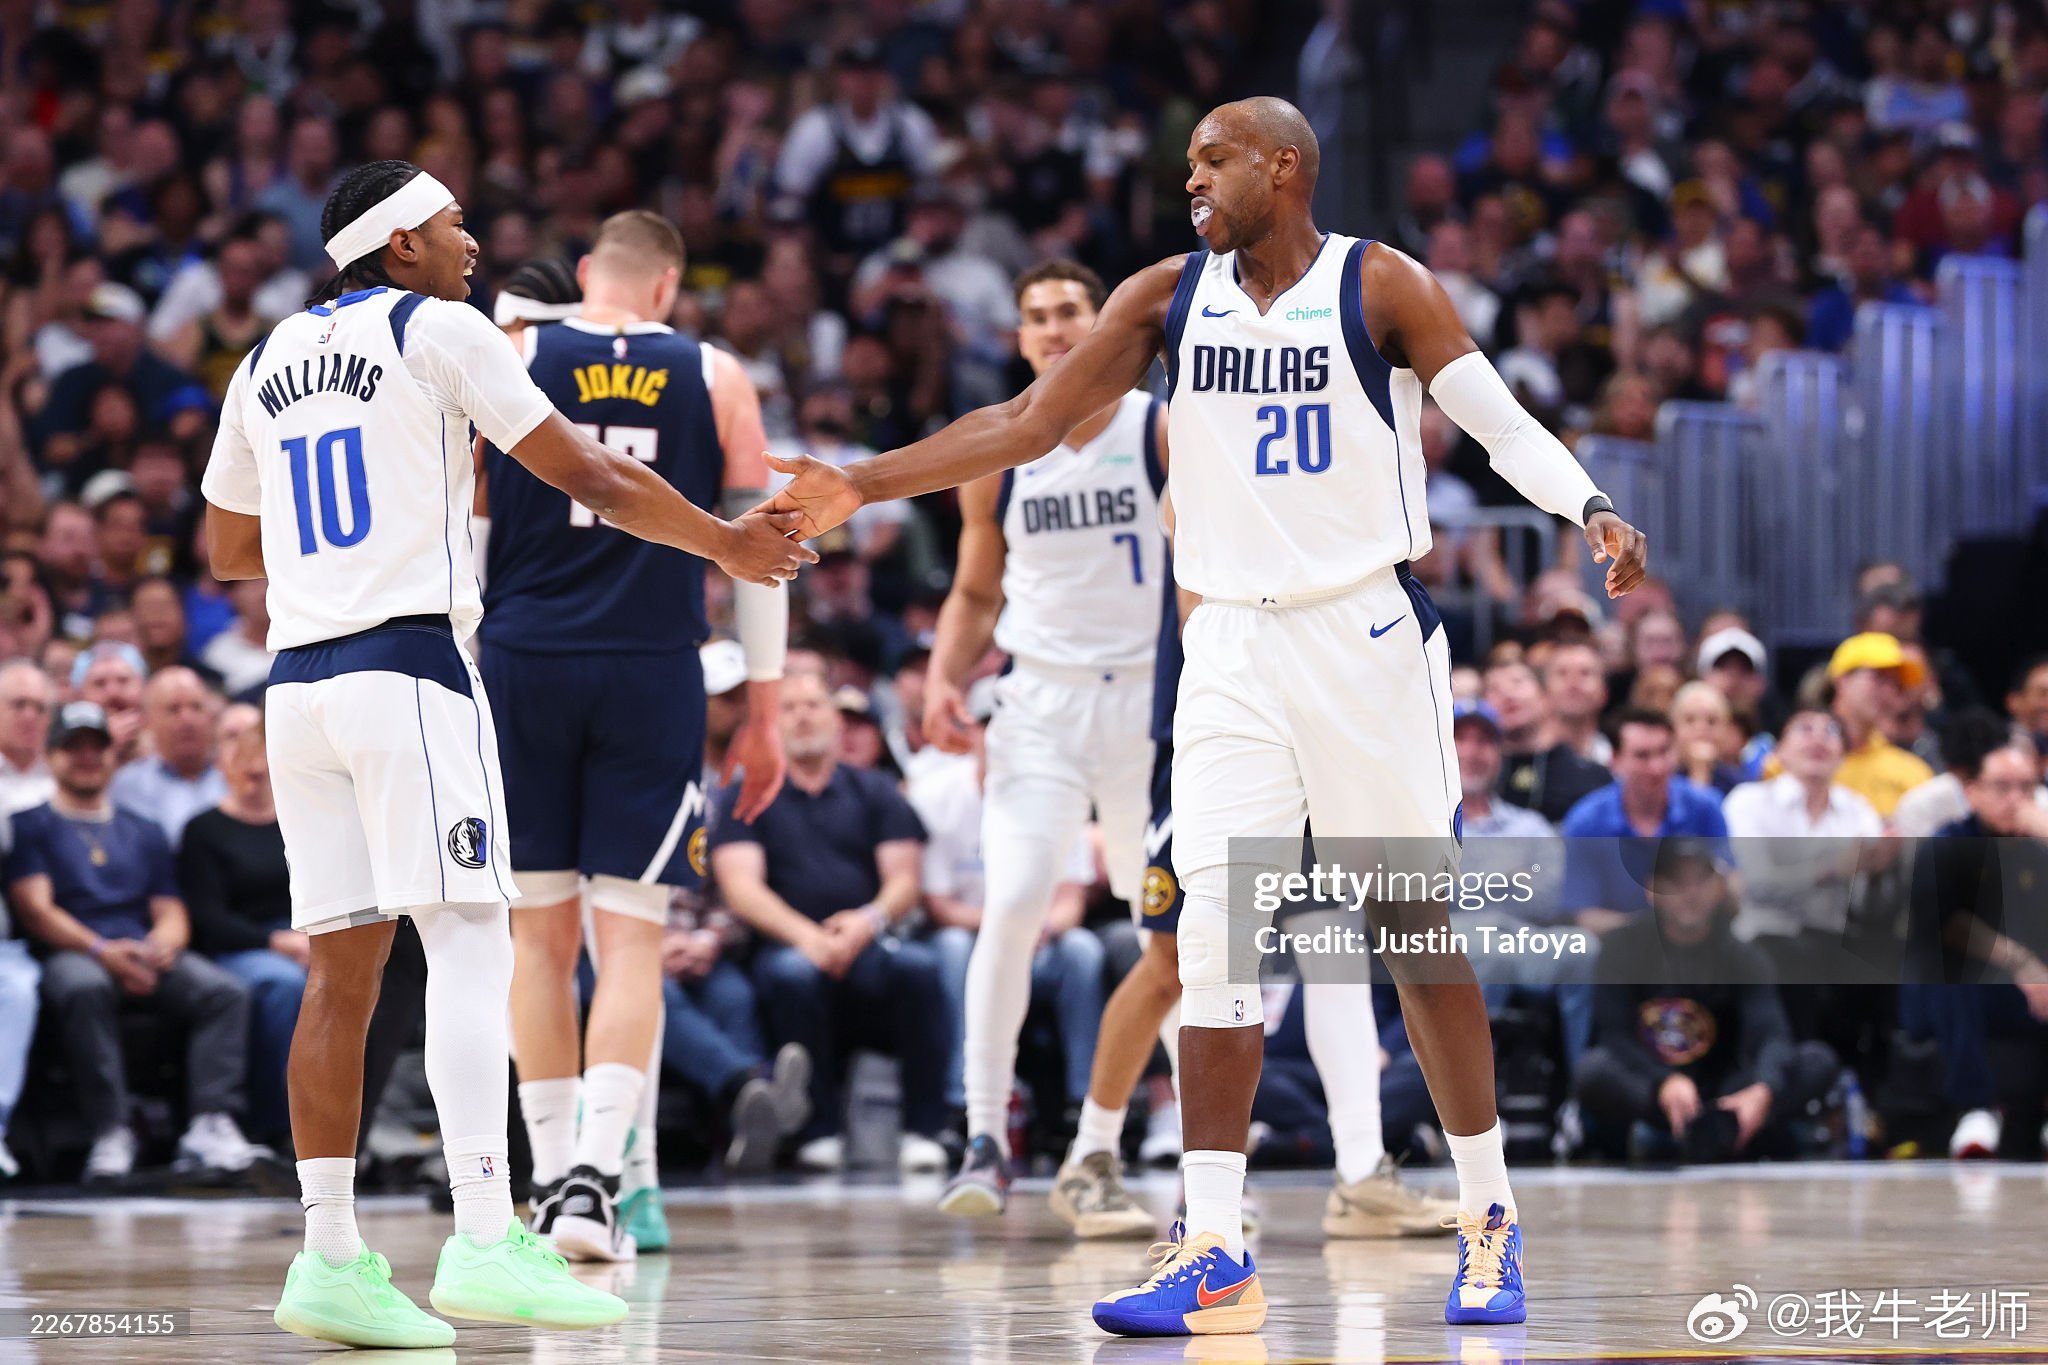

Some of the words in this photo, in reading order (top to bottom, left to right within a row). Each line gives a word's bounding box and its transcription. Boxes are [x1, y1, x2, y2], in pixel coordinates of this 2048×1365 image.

[1286, 306, 1333, 321] chime
[257, 352, 384, 419] WILLIAMS
[1192, 344, 1331, 394] DALLAS
[1255, 402, 1332, 477] 20
[280, 425, 372, 558] 10
[1023, 486, 1137, 535] DALLAS
[1112, 532, 1144, 586] 7
